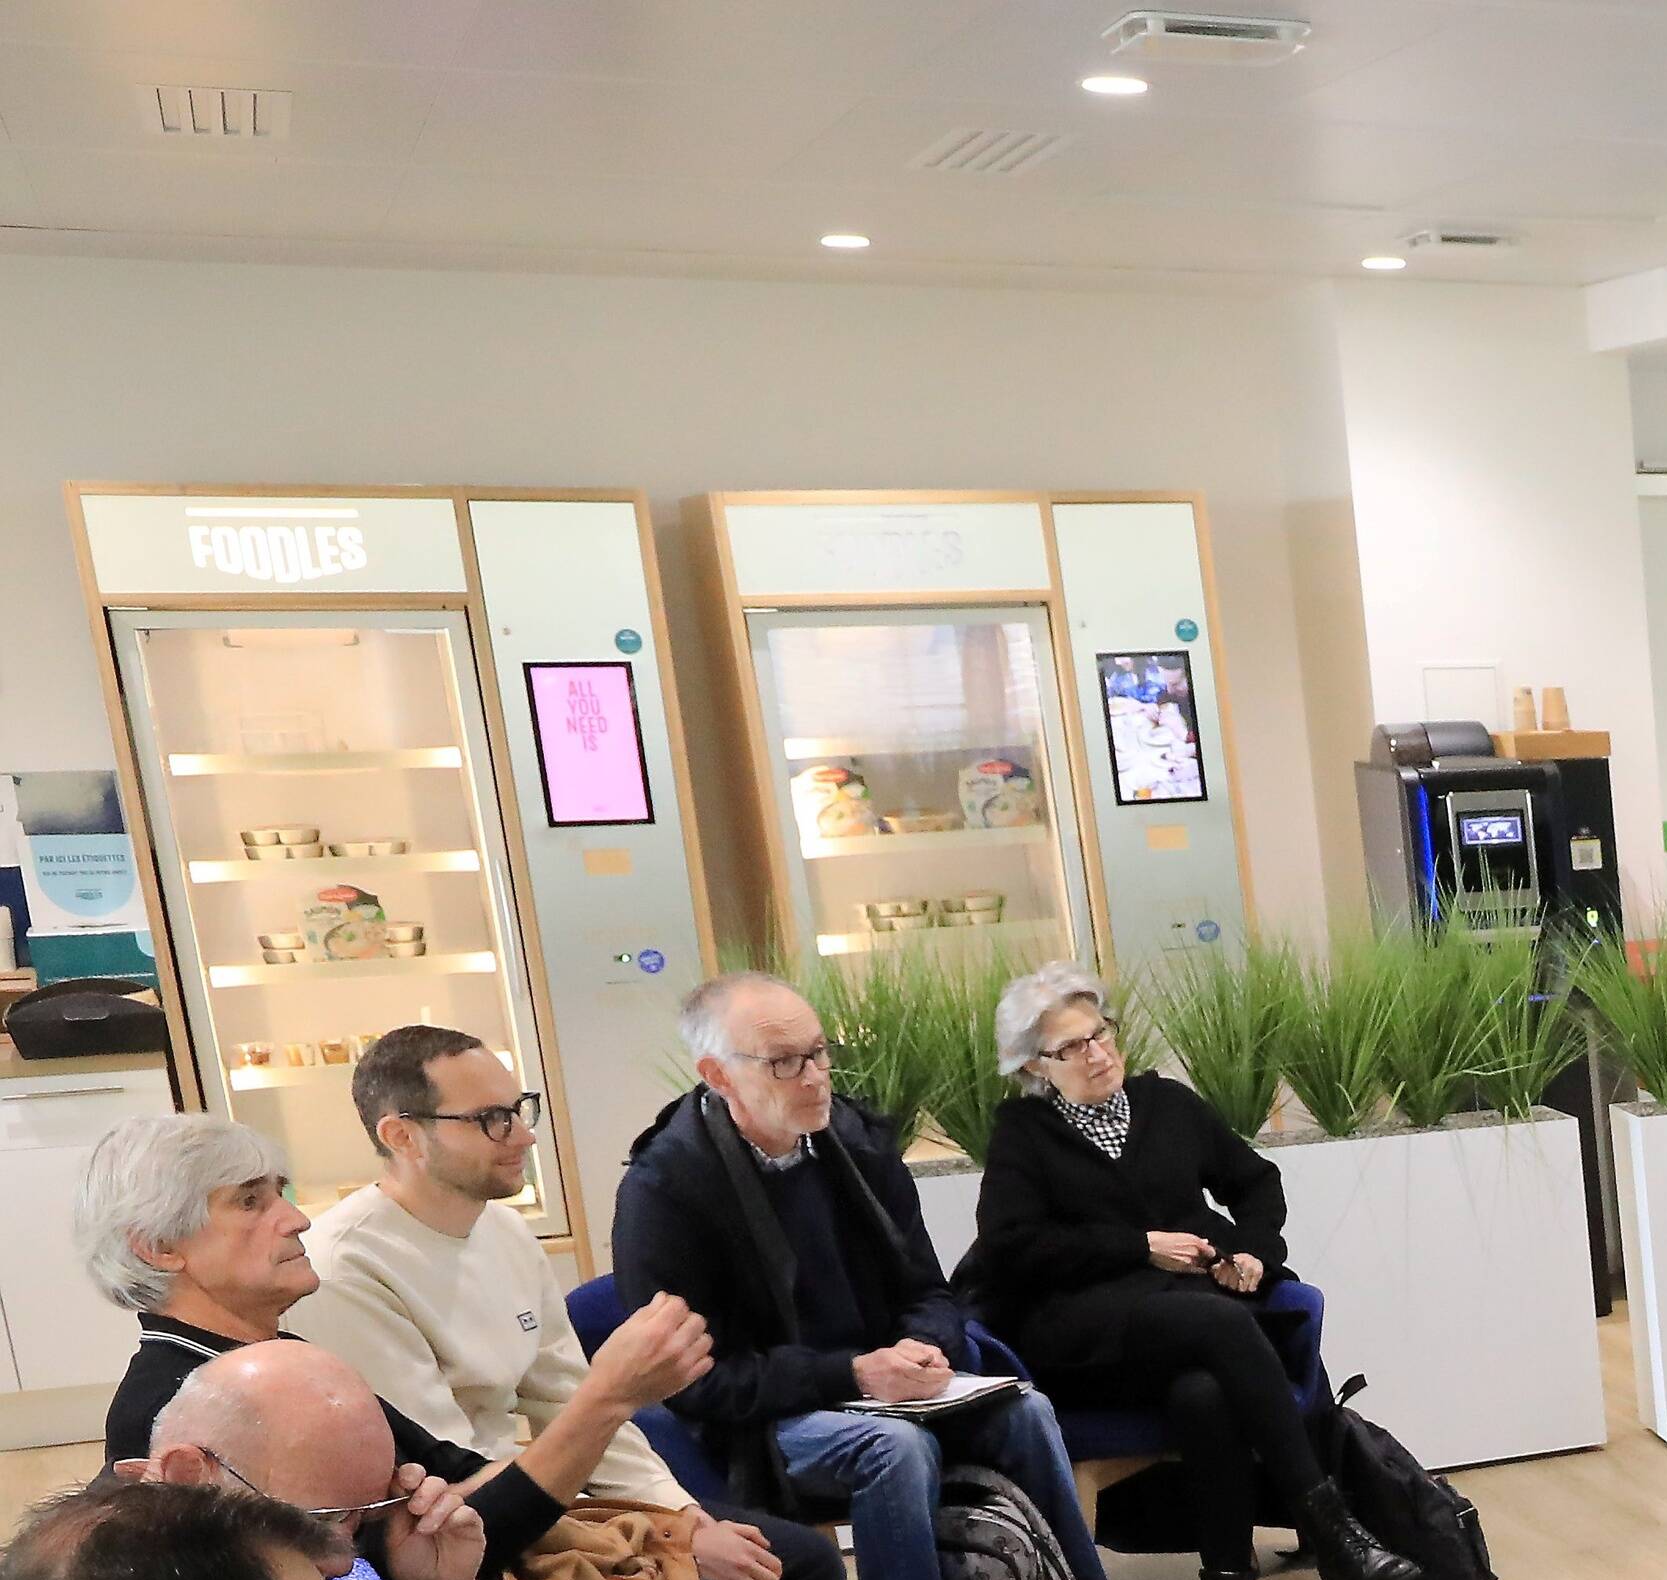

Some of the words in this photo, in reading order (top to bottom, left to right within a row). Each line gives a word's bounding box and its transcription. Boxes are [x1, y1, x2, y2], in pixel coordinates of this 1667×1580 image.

[188, 525, 367, 583] FOODLES
[568, 680, 597, 697] ALL
[567, 699, 600, 715] YOU
[566, 716, 608, 733] NEED
[582, 735, 598, 751] IS
